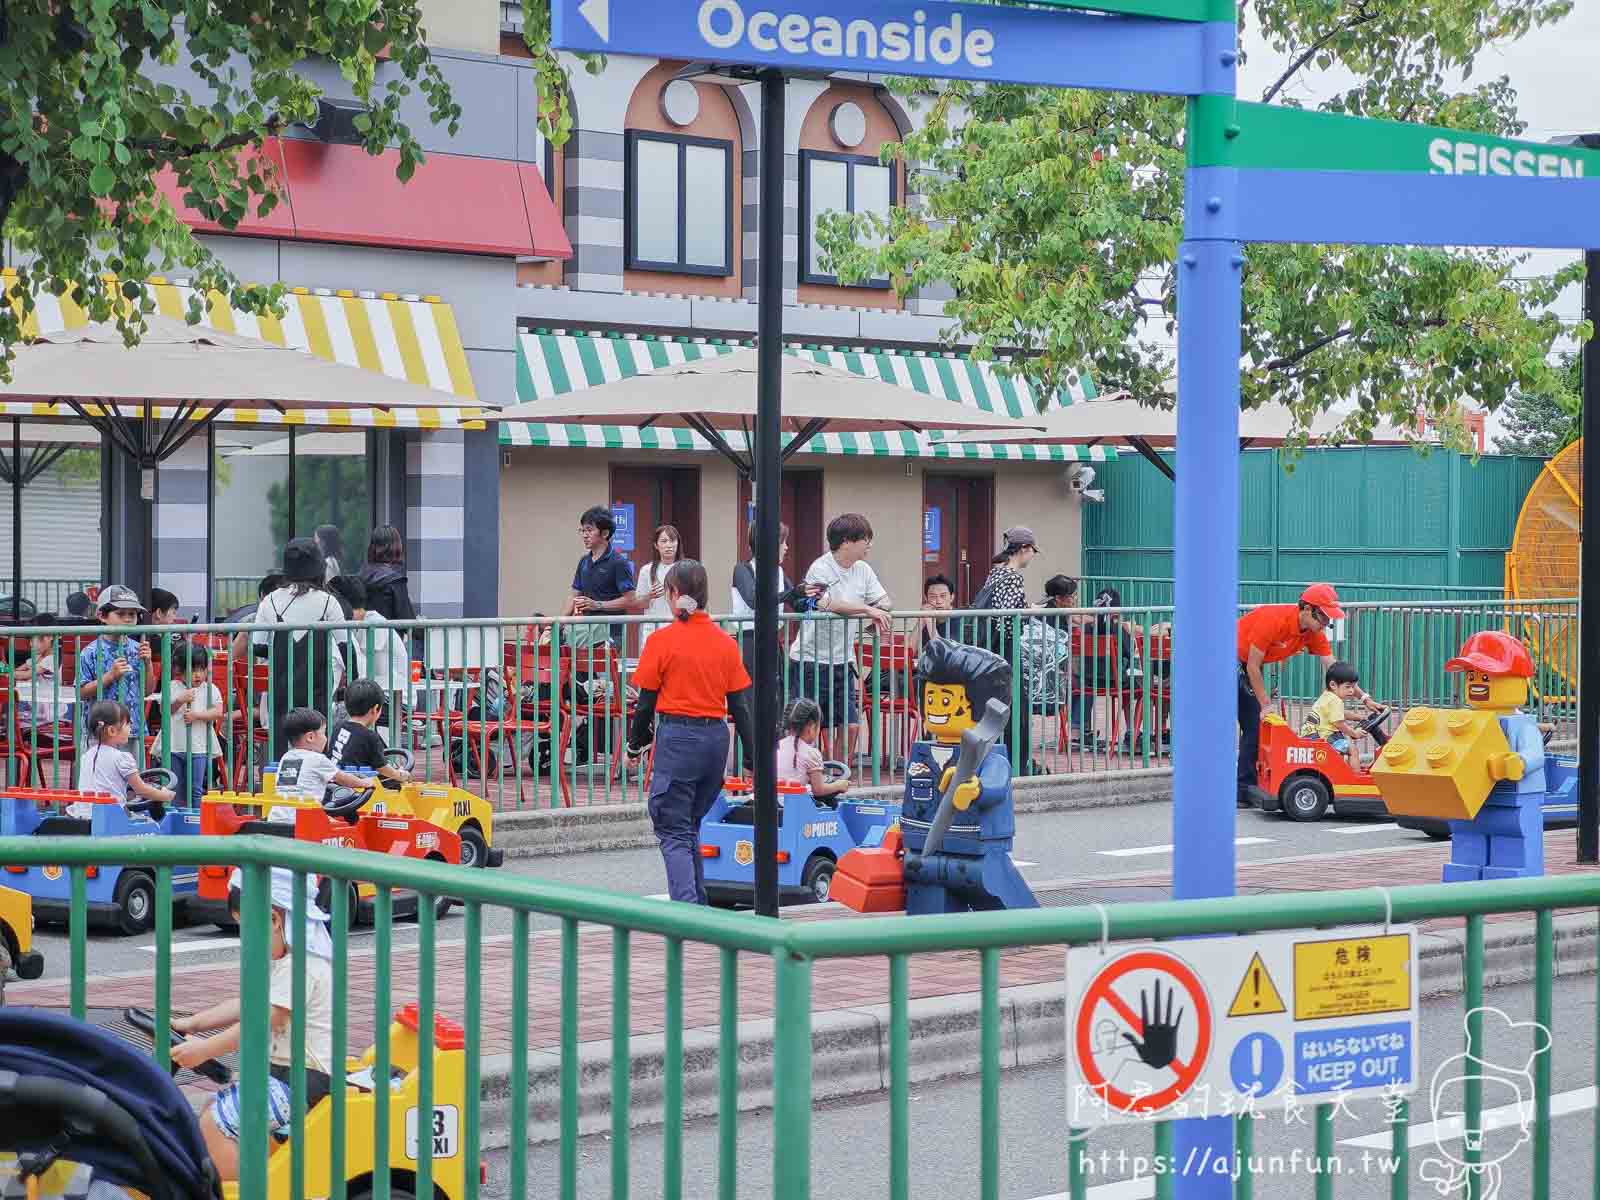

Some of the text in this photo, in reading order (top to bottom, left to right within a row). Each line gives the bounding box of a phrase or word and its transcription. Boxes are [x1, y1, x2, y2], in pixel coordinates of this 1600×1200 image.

[697, 0, 994, 67] Oceanside
[1286, 746, 1315, 764] FIRE
[453, 800, 471, 817] TAXI
[812, 821, 838, 838] POLICE
[1302, 1032, 1405, 1059] はいらないでね
[1306, 1055, 1400, 1083] KEEP OUT
